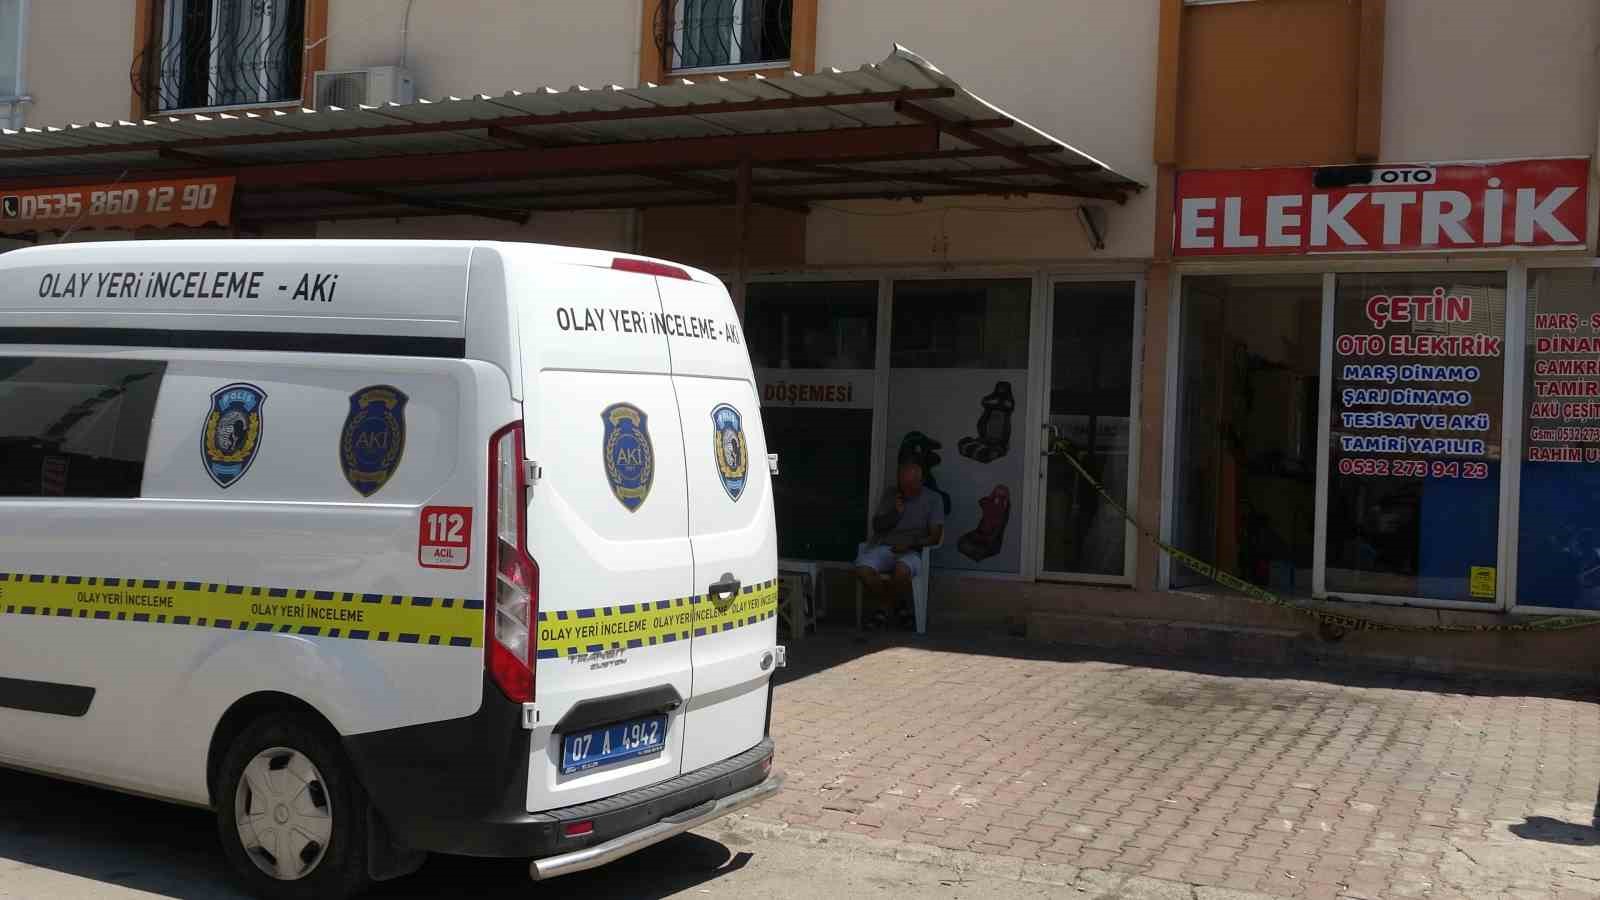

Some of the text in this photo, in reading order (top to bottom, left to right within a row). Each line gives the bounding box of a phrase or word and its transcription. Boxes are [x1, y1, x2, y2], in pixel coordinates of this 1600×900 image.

[1380, 170, 1433, 183] OTO
[20, 184, 217, 219] 0535 860 12 90
[1180, 177, 1580, 249] ELEKTRİK
[38, 273, 92, 298] OLAY
[1366, 287, 1472, 329] ÇETİN
[556, 307, 605, 331] OLAY
[1337, 334, 1385, 355] OTO
[1343, 365, 1397, 383] MARŞ
[1535, 359, 1600, 375] CAMKR
[1343, 389, 1388, 407] ŞARJ
[1419, 414, 1446, 428] VE
[1450, 414, 1489, 430] AKÜ
[1407, 438, 1484, 454] YAPILIR
[1339, 459, 1488, 479] 0532 273 94 23
[427, 513, 464, 542] 112
[77, 591, 100, 604] OLAY
[251, 603, 279, 616] OLAY
[541, 627, 573, 642] OLAY
[653, 614, 674, 628] OLAY
[572, 721, 658, 761] 07 A 4942
